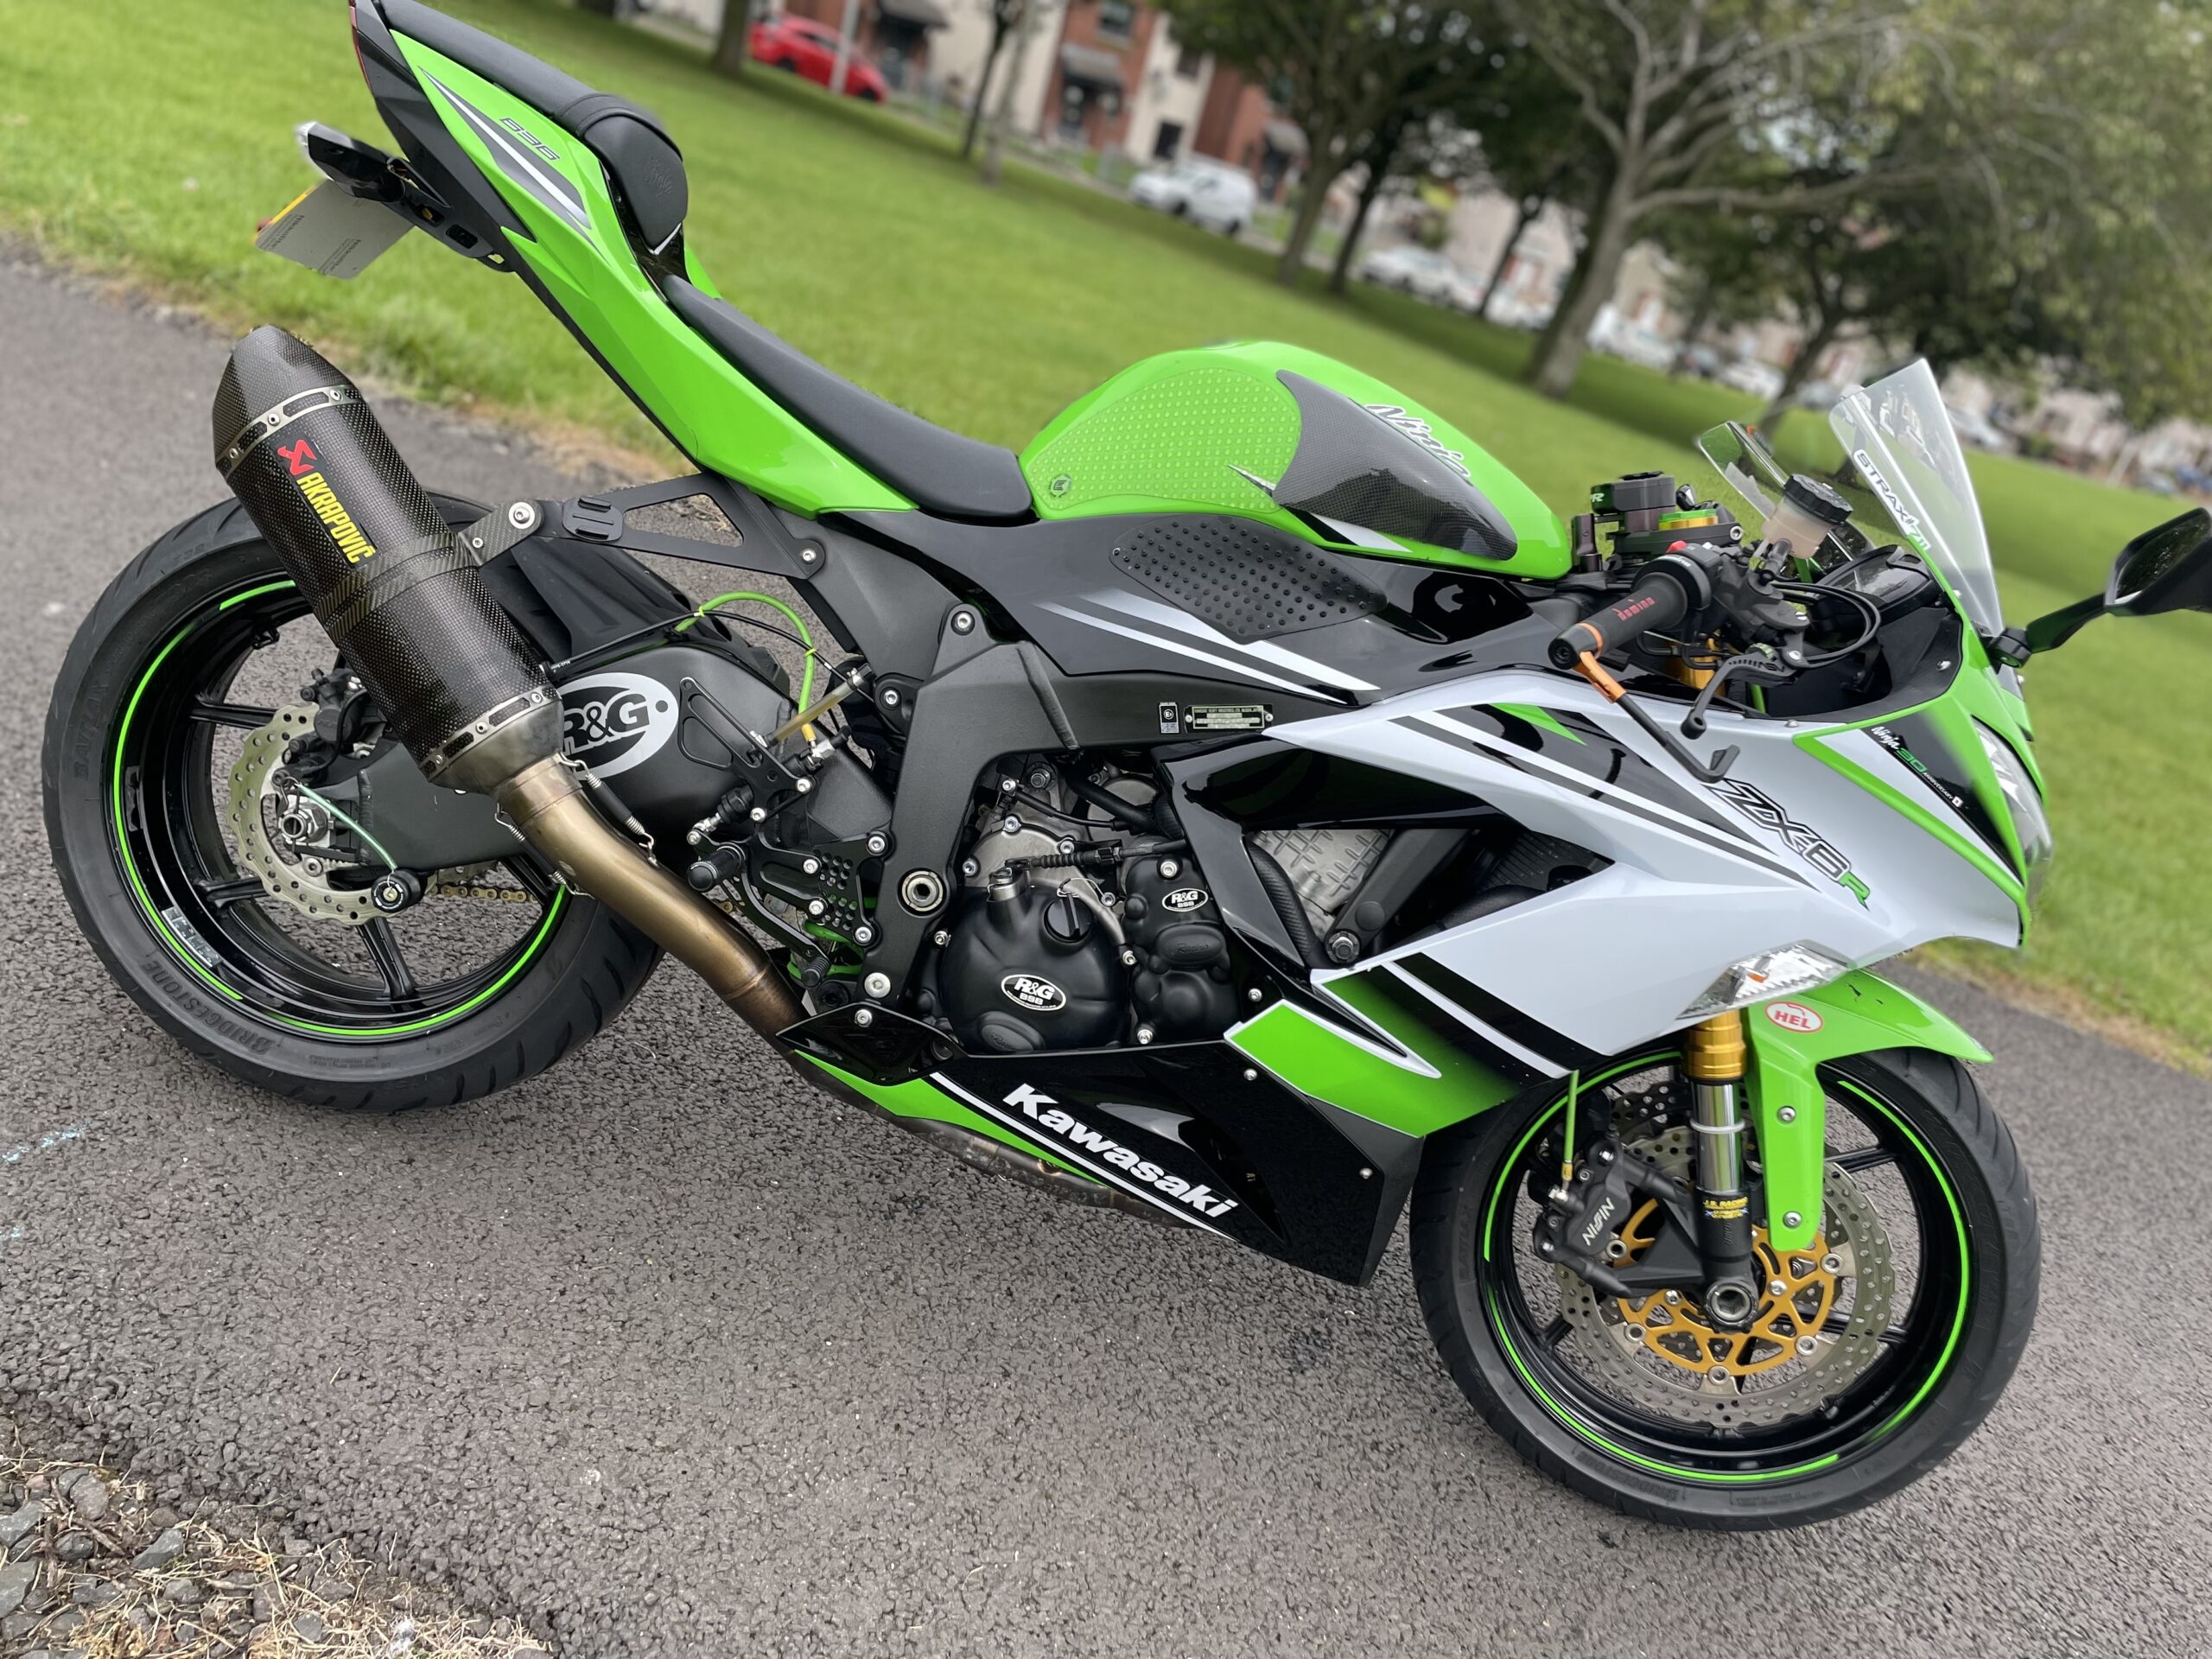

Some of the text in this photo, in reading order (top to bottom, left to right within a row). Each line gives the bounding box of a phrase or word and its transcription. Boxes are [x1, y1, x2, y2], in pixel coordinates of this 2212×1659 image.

[499, 118, 560, 160] 636
[1871, 726, 1900, 750] Ninja
[1172, 891, 1198, 904] R&G
[1014, 977, 1056, 1001] R&G
[1020, 993, 1043, 1005] BSB
[142, 958, 275, 1055] BRIDGESTONE
[1774, 1010, 1811, 1028] HEL
[1002, 1083, 1238, 1217] Kawasaki
